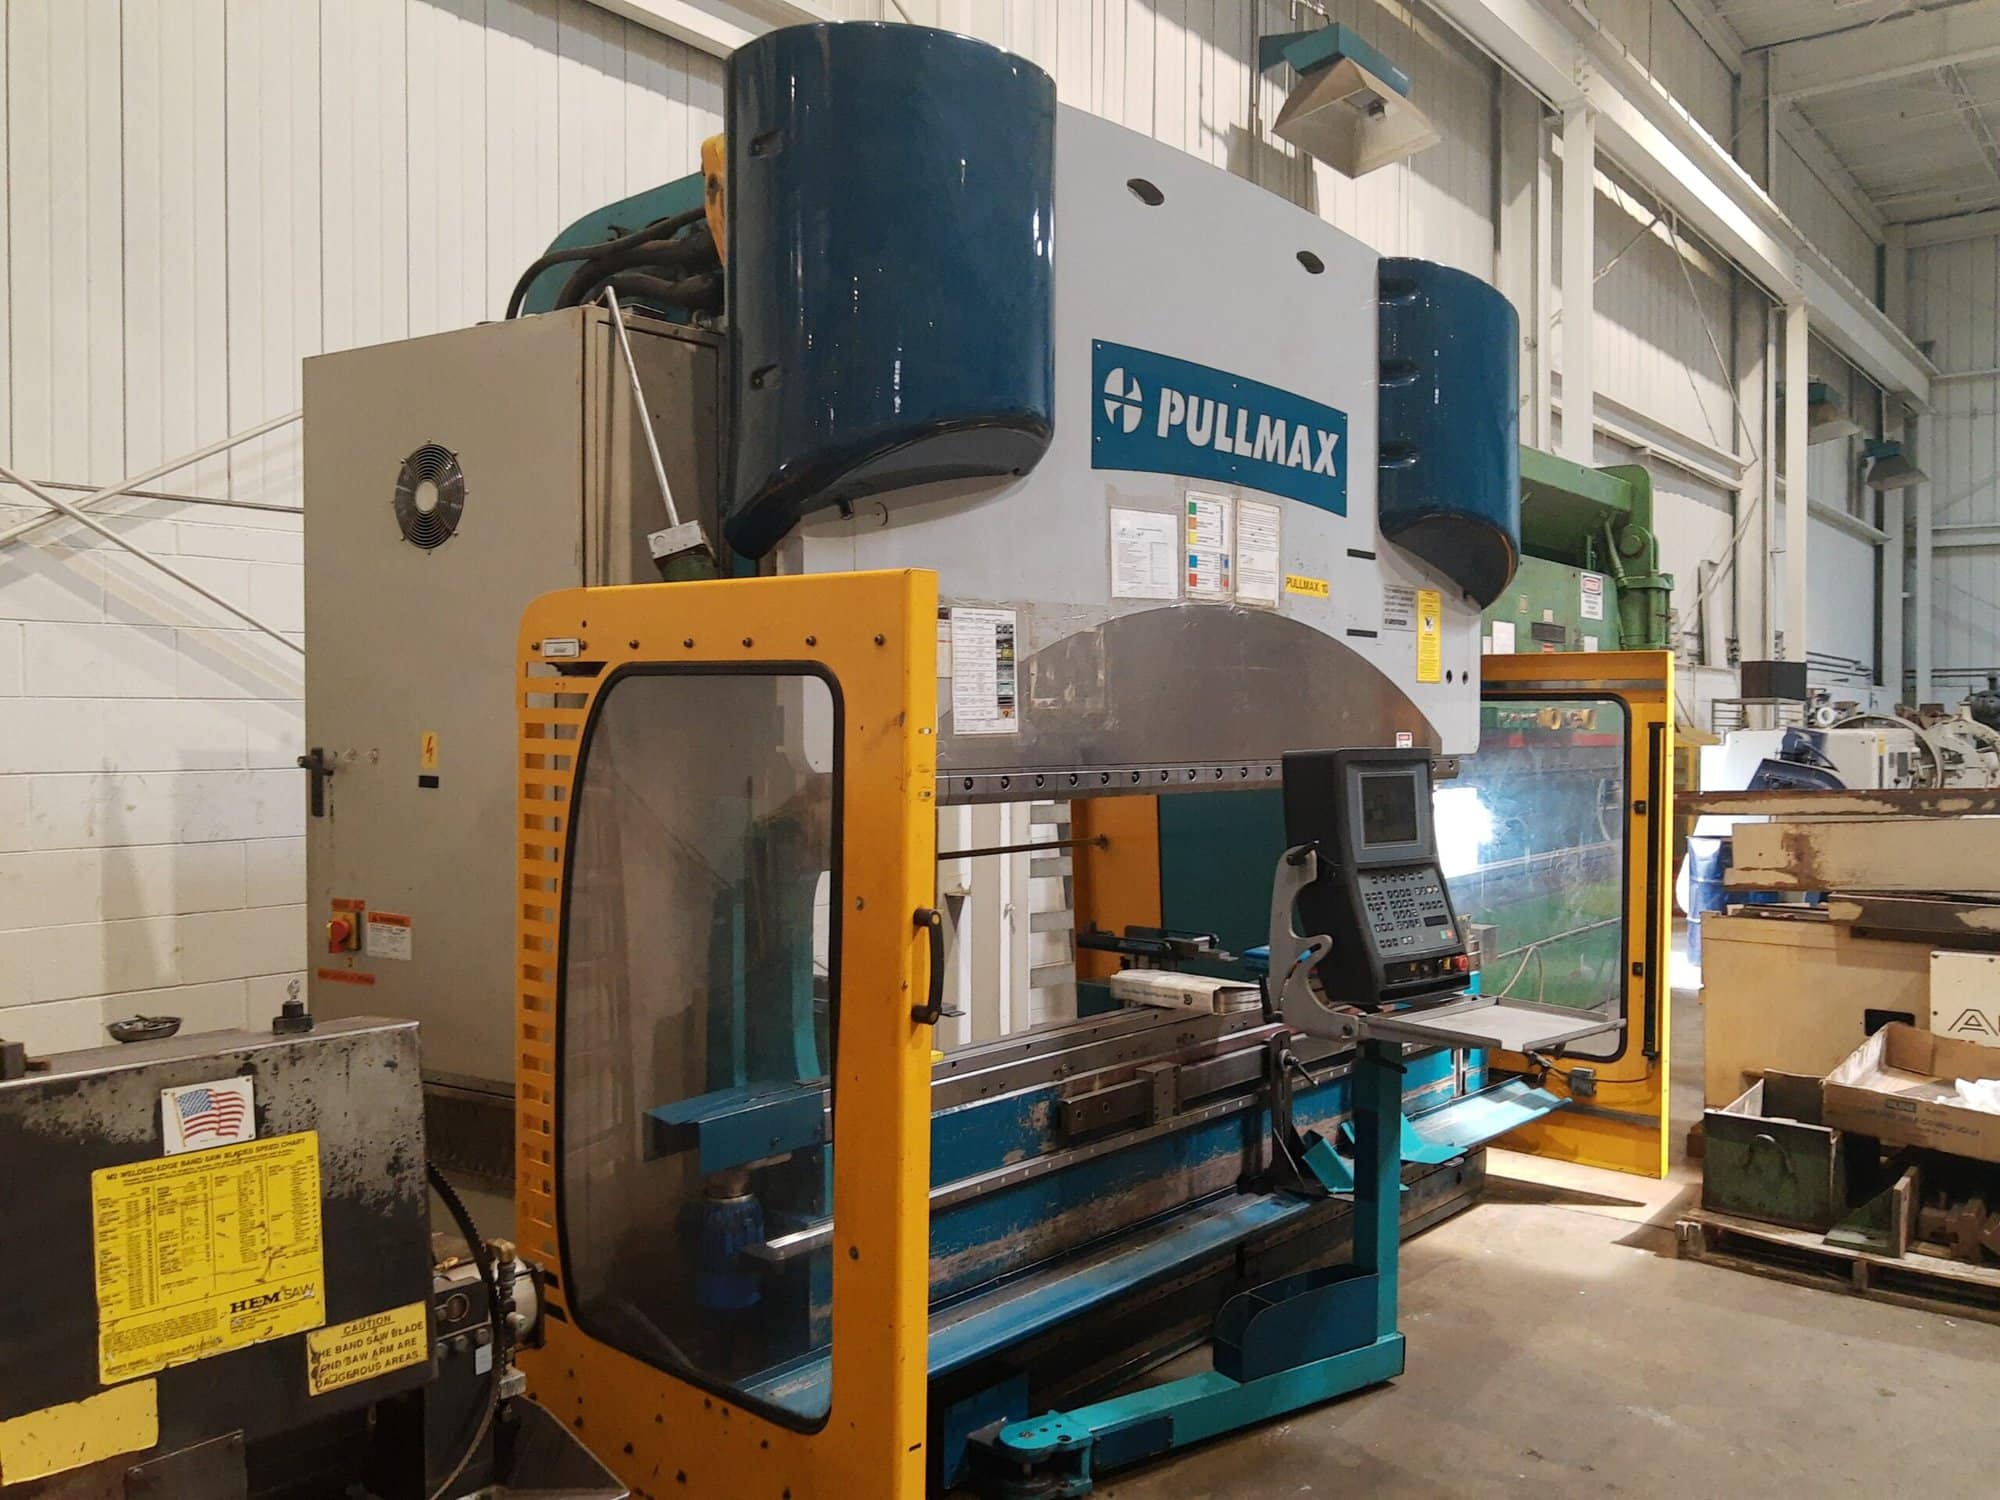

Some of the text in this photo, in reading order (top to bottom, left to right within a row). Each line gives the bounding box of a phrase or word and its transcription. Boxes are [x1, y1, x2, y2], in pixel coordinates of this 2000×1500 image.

[1157, 388, 1340, 477] PULLMAX
[1286, 577, 1320, 592] PULLMAX
[229, 1283, 315, 1314] HEM SAW
[335, 1338, 364, 1354] BAND
[366, 1331, 389, 1346] SAW
[391, 1320, 424, 1338] BLADE
[343, 1314, 391, 1335] CAUTION
[343, 1352, 368, 1366] SAW
[372, 1344, 394, 1360] ARM
[397, 1337, 417, 1350] ARE
